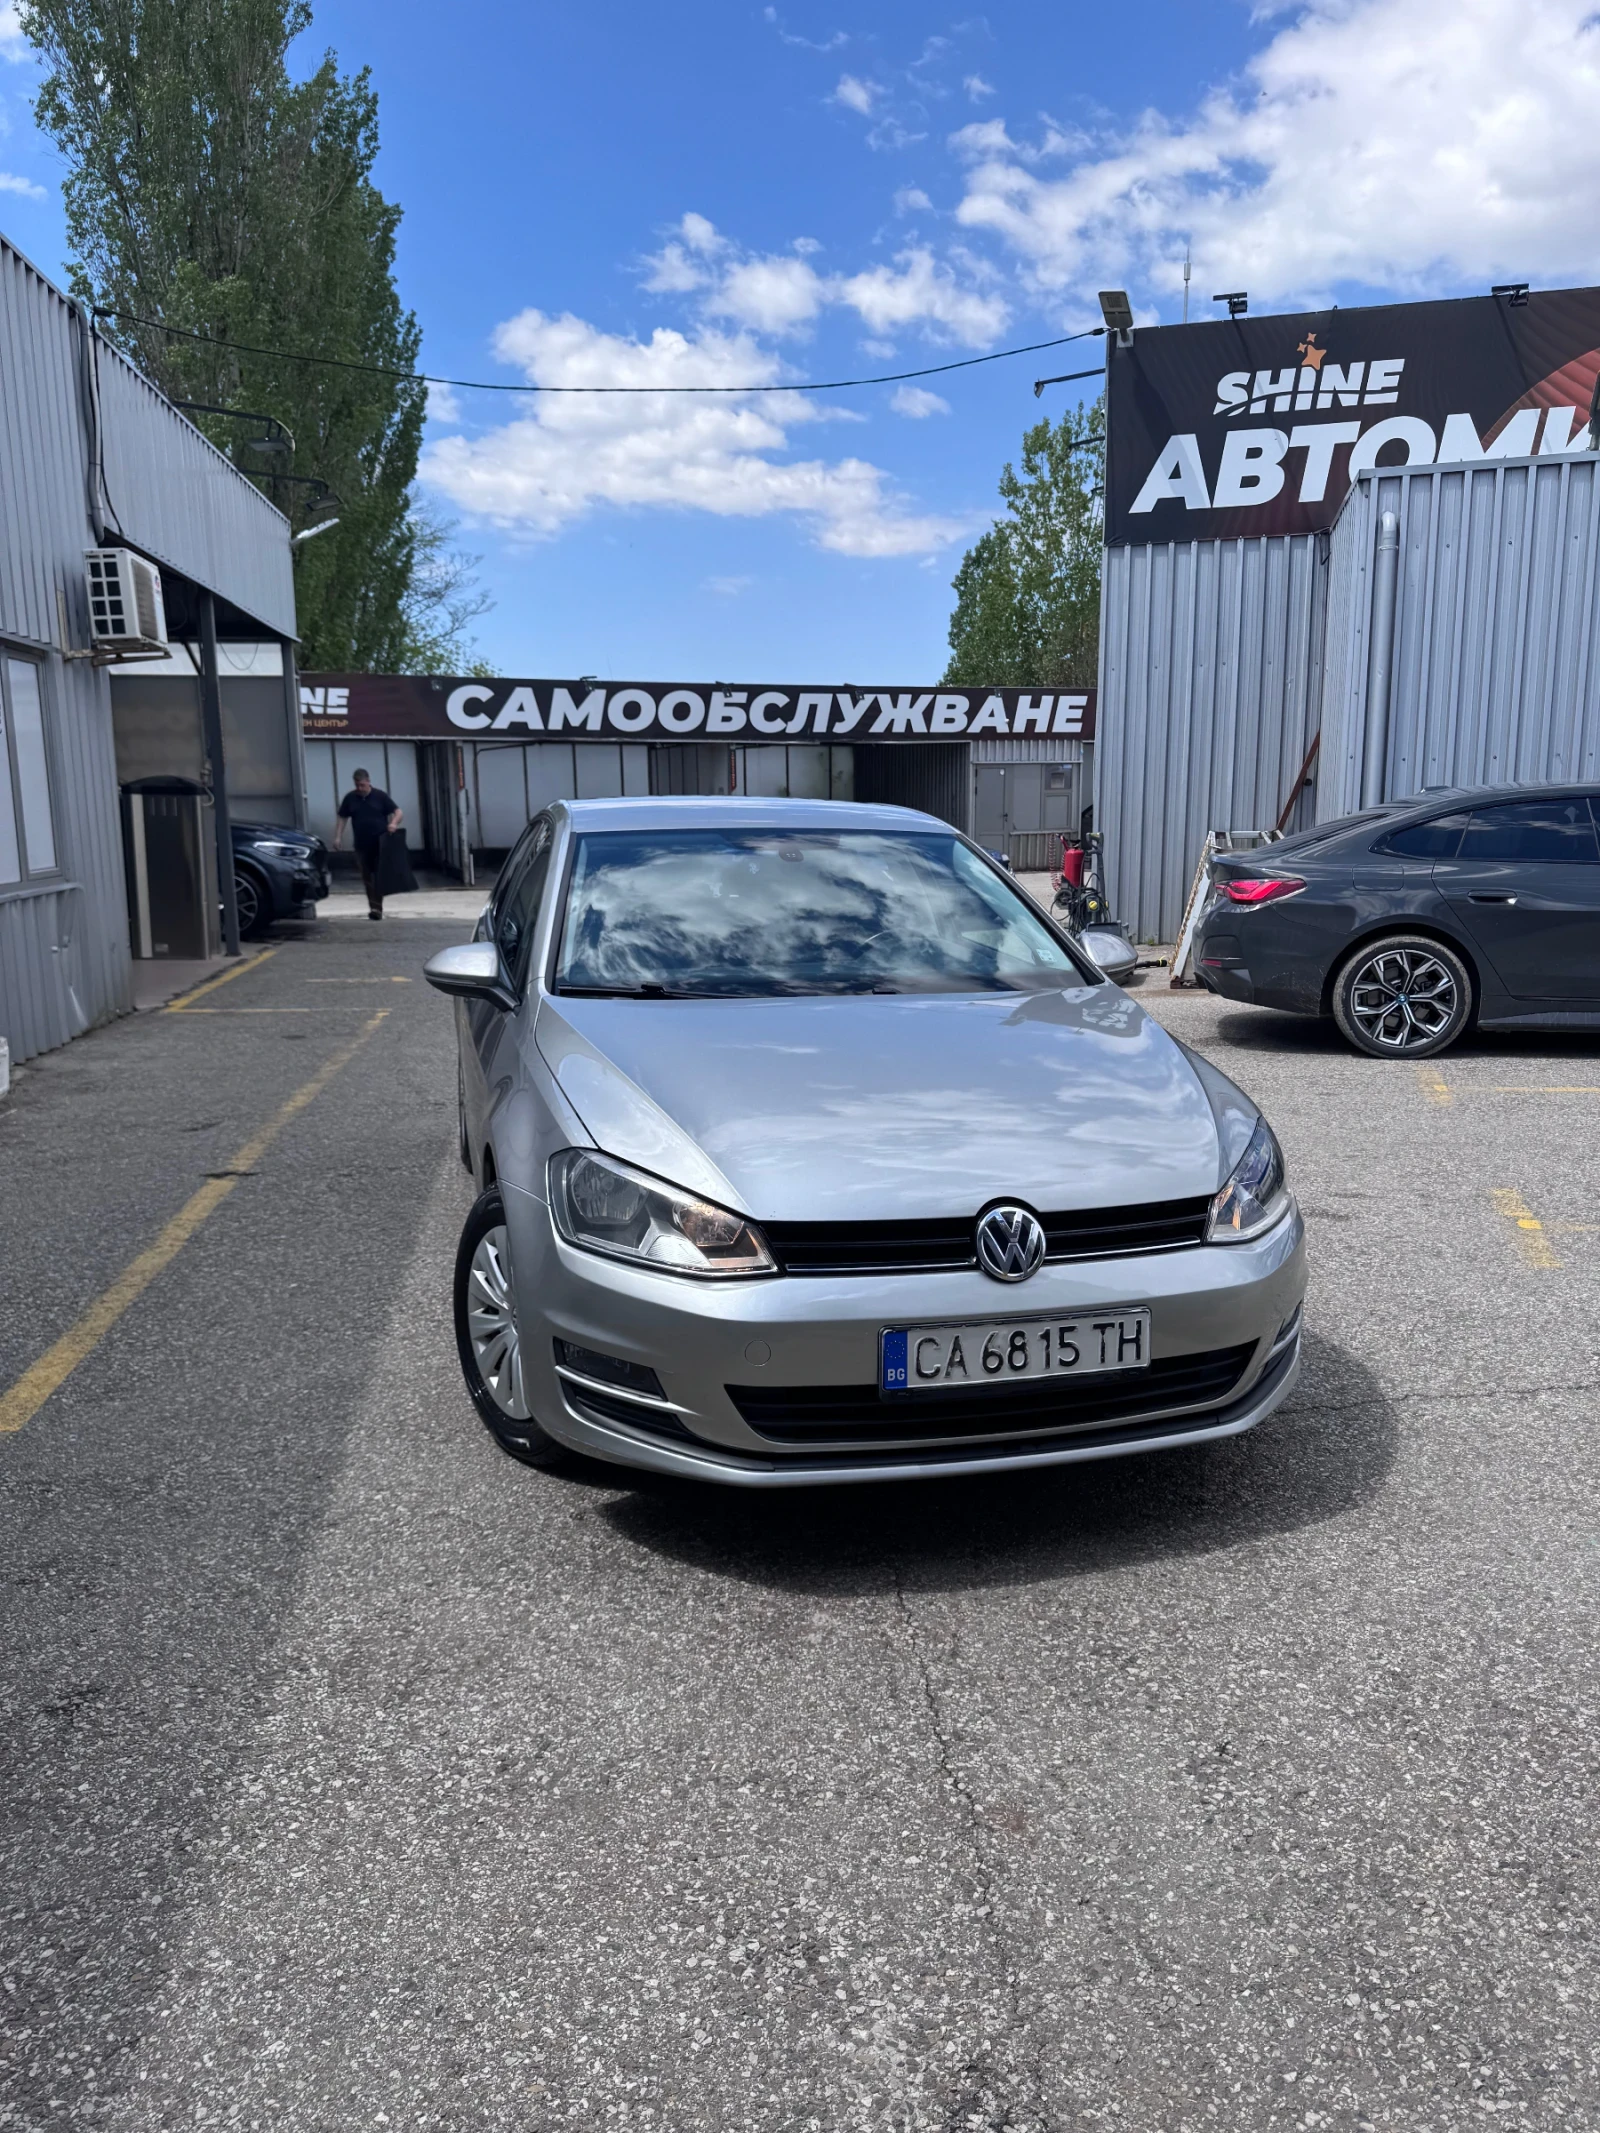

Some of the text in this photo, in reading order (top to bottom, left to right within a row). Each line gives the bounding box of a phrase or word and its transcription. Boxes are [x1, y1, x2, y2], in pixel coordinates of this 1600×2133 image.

[1213, 358, 1405, 417] SHINE
[446, 684, 1089, 734] САМООБСЛУЖВАНЕ
[887, 1368, 905, 1382] BG
[915, 1319, 1143, 1379] CA 6815 TH
